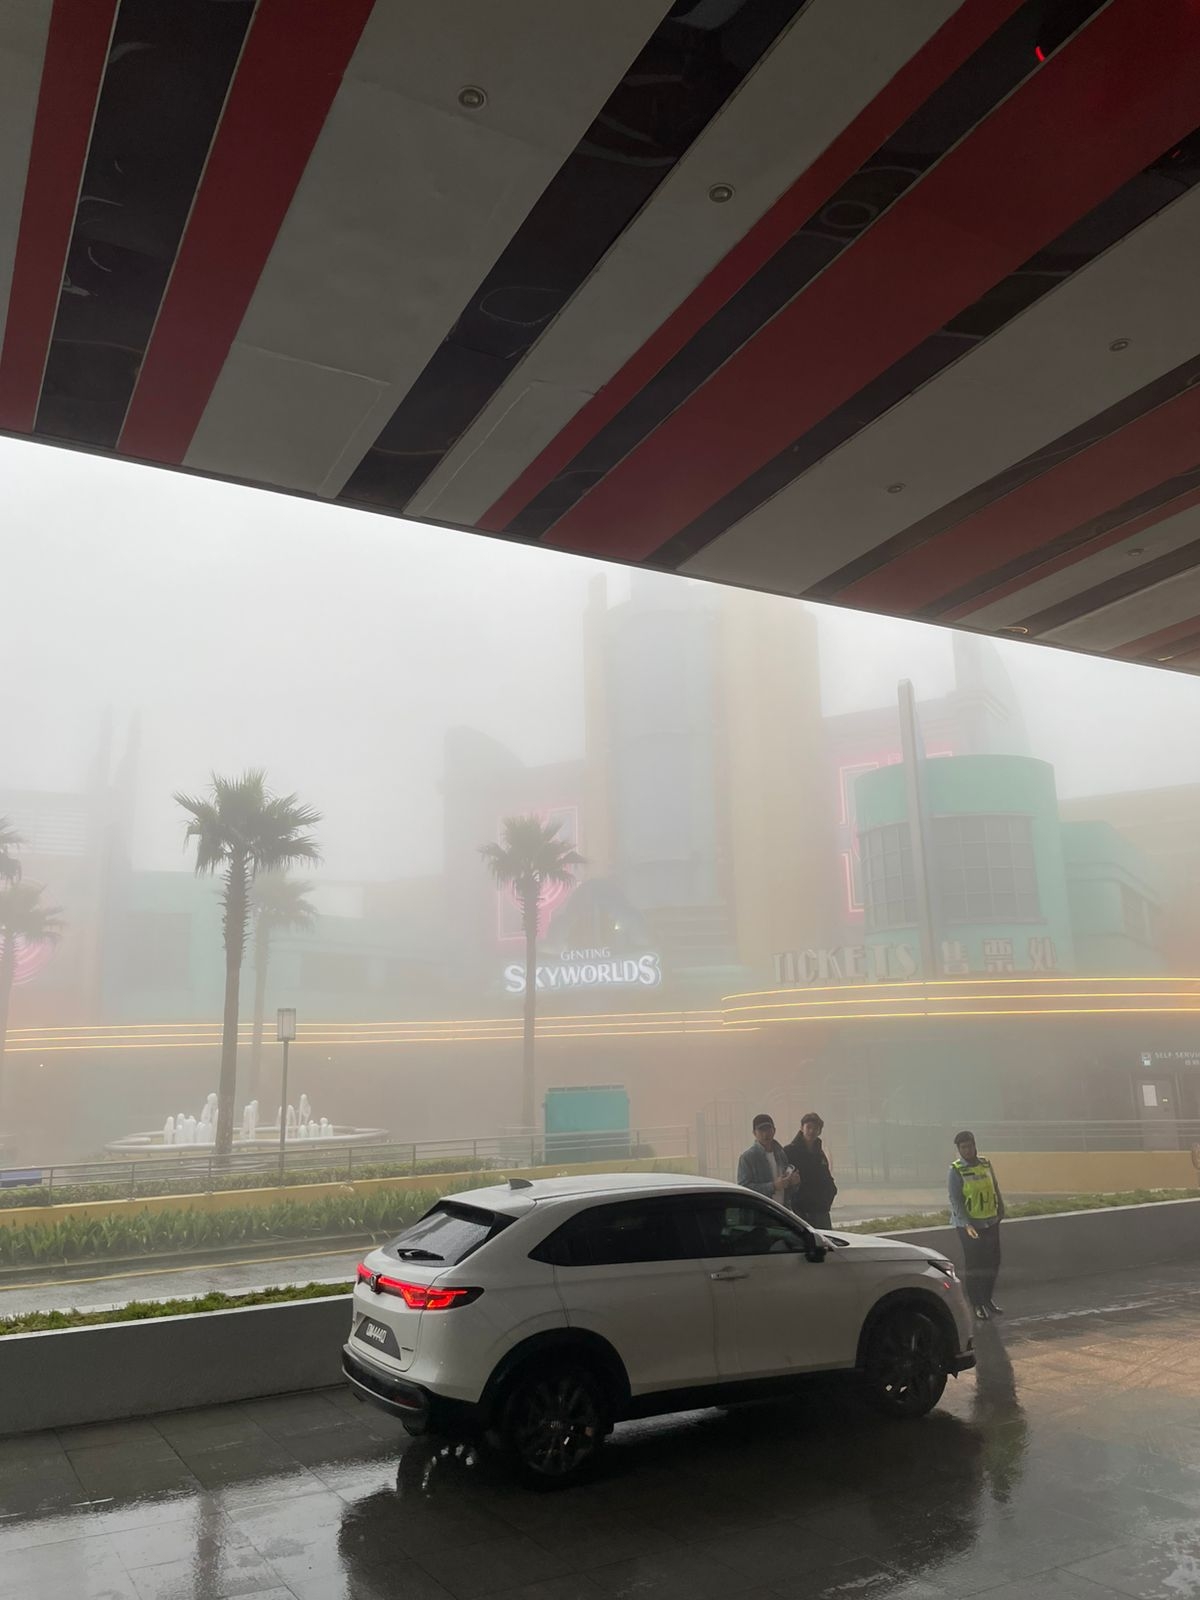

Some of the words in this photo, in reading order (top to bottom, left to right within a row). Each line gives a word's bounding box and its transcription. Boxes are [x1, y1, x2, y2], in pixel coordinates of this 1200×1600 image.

[504, 953, 662, 992] SKYWORLDS
[560, 947, 611, 961] GENTING
[772, 943, 917, 983] TICKETS
